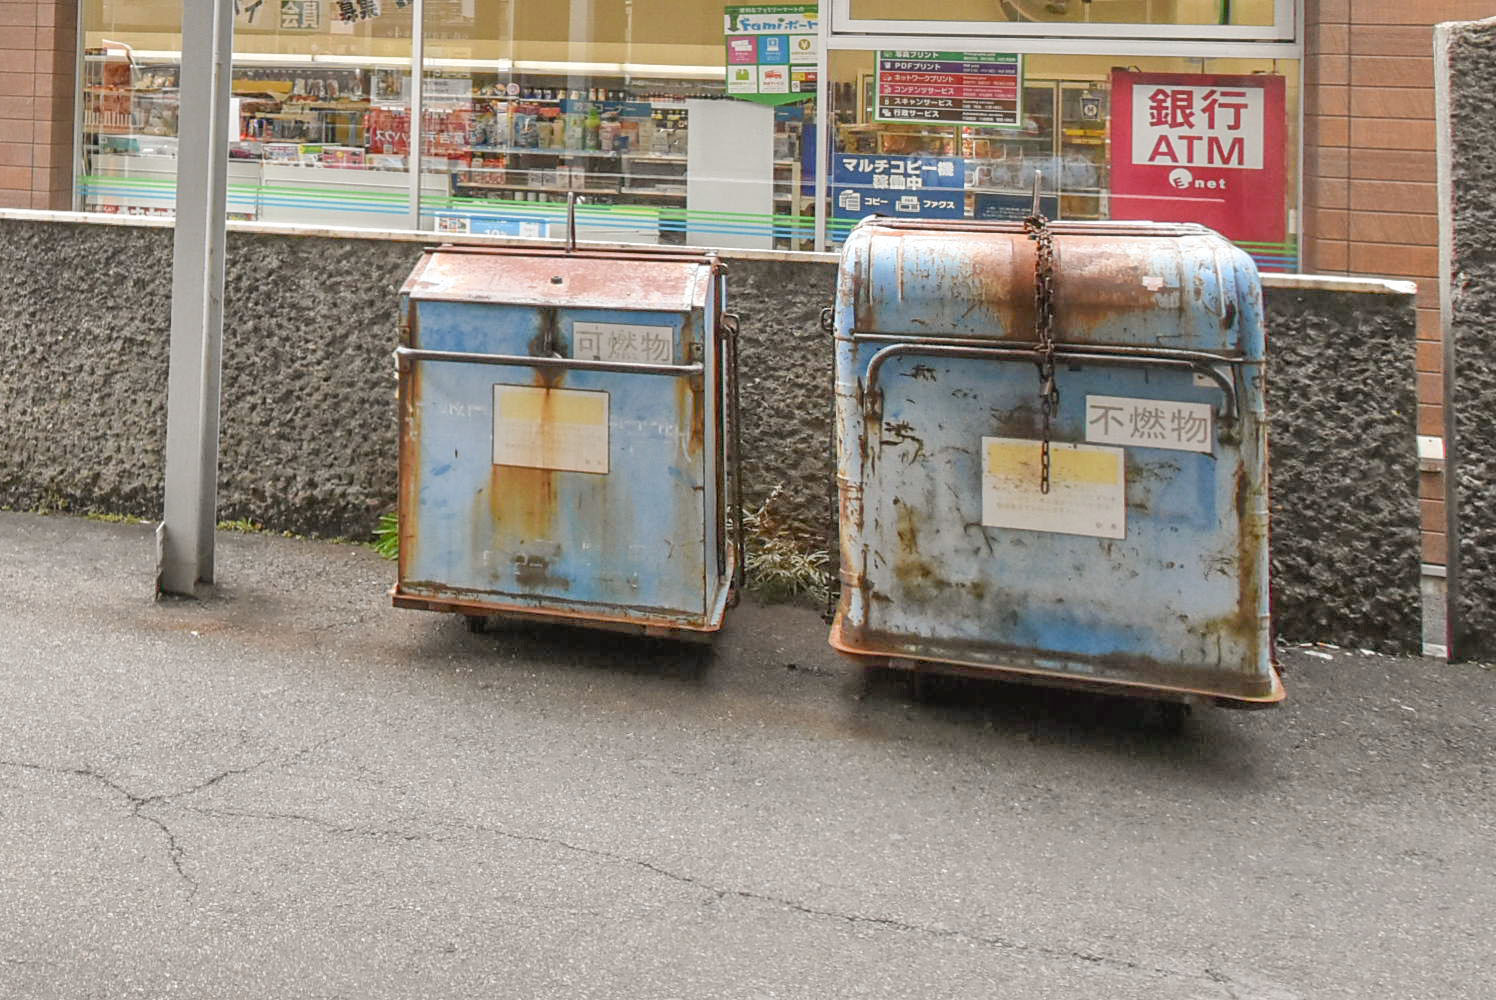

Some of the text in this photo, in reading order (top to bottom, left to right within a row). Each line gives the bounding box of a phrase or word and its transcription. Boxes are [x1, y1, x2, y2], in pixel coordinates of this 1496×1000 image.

[894, 62, 941, 71] PDFプリント
[893, 97, 953, 108] スキャンサービス
[1148, 88, 1249, 131] 銀行
[1147, 134, 1245, 166] ATM
[842, 158, 955, 177] マルチコピー機
[864, 196, 889, 206] コピー
[922, 199, 956, 209] ファクス
[575, 328, 672, 363] 可燃物
[1089, 403, 1208, 445] 不燃物
